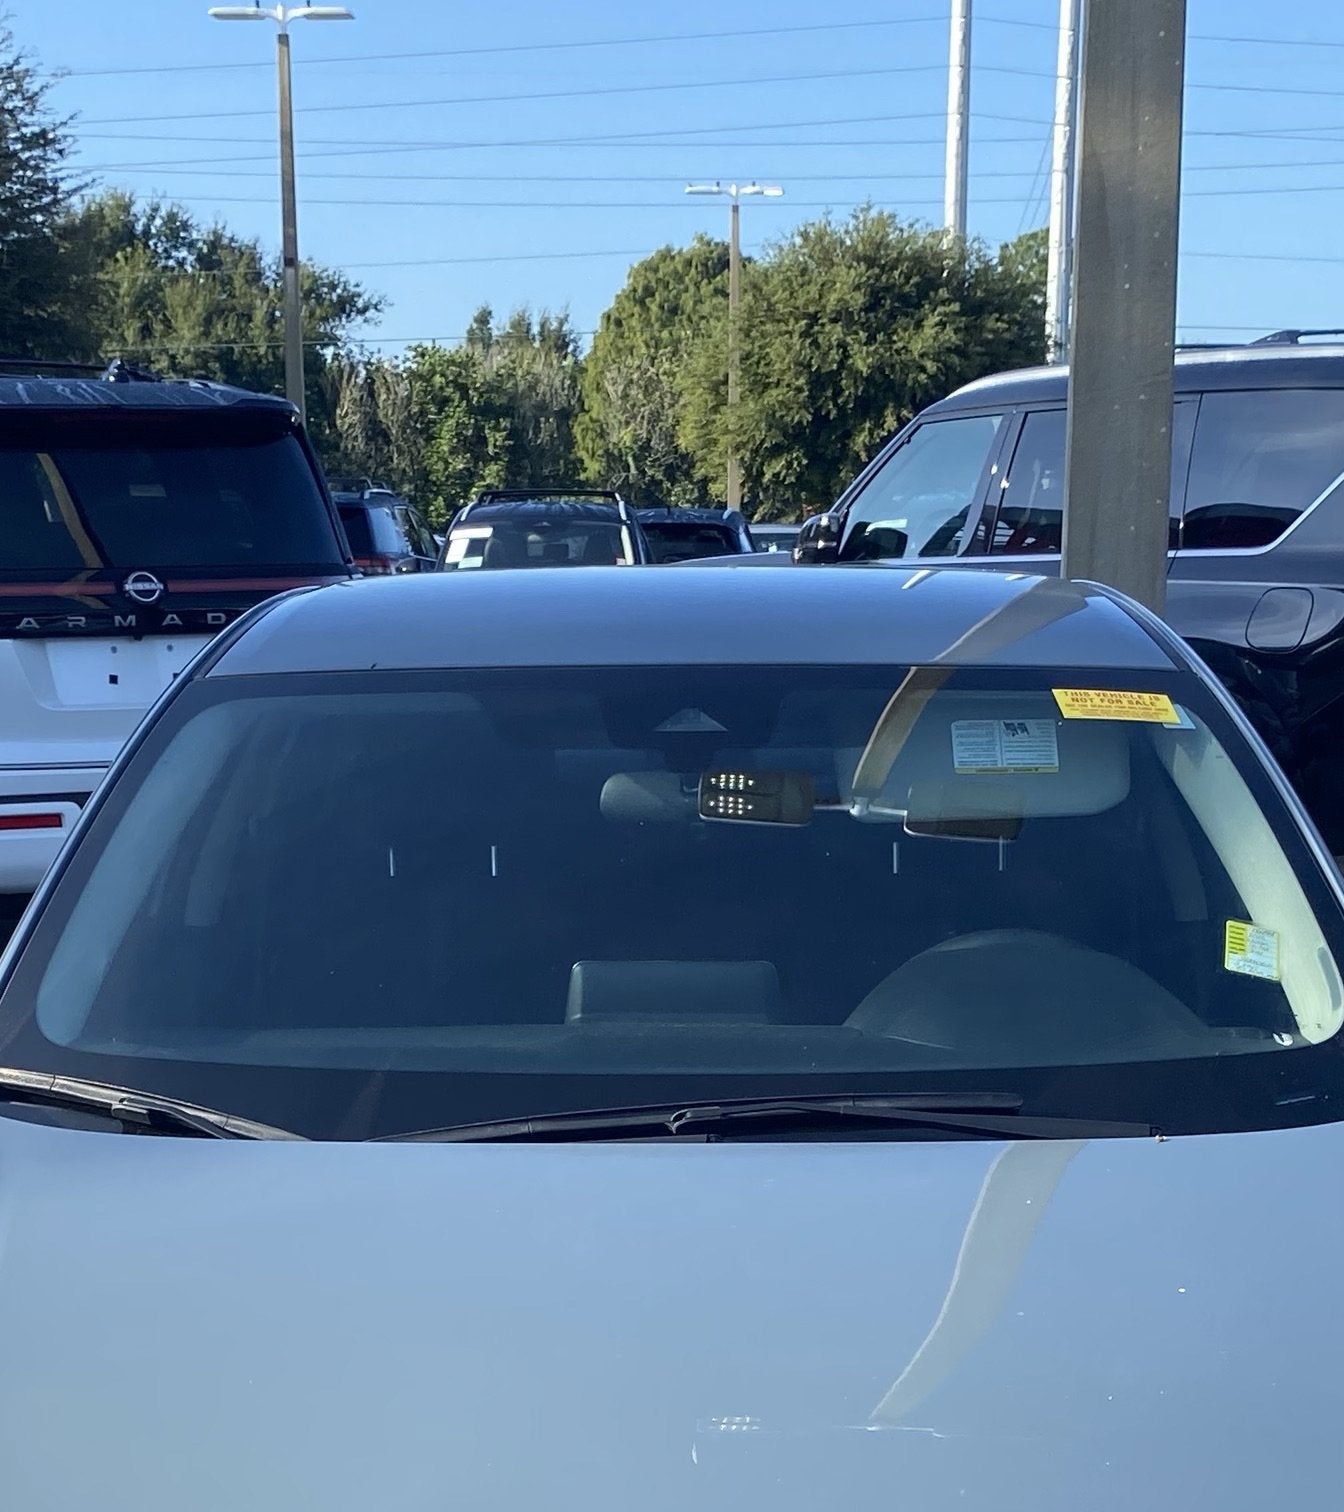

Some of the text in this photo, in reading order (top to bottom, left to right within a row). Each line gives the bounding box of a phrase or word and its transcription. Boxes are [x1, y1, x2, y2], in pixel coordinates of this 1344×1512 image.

[15, 612, 228, 630] ARMAD
[1096, 692, 1146, 700] VEHICLE
[1128, 699, 1157, 707] SALE
